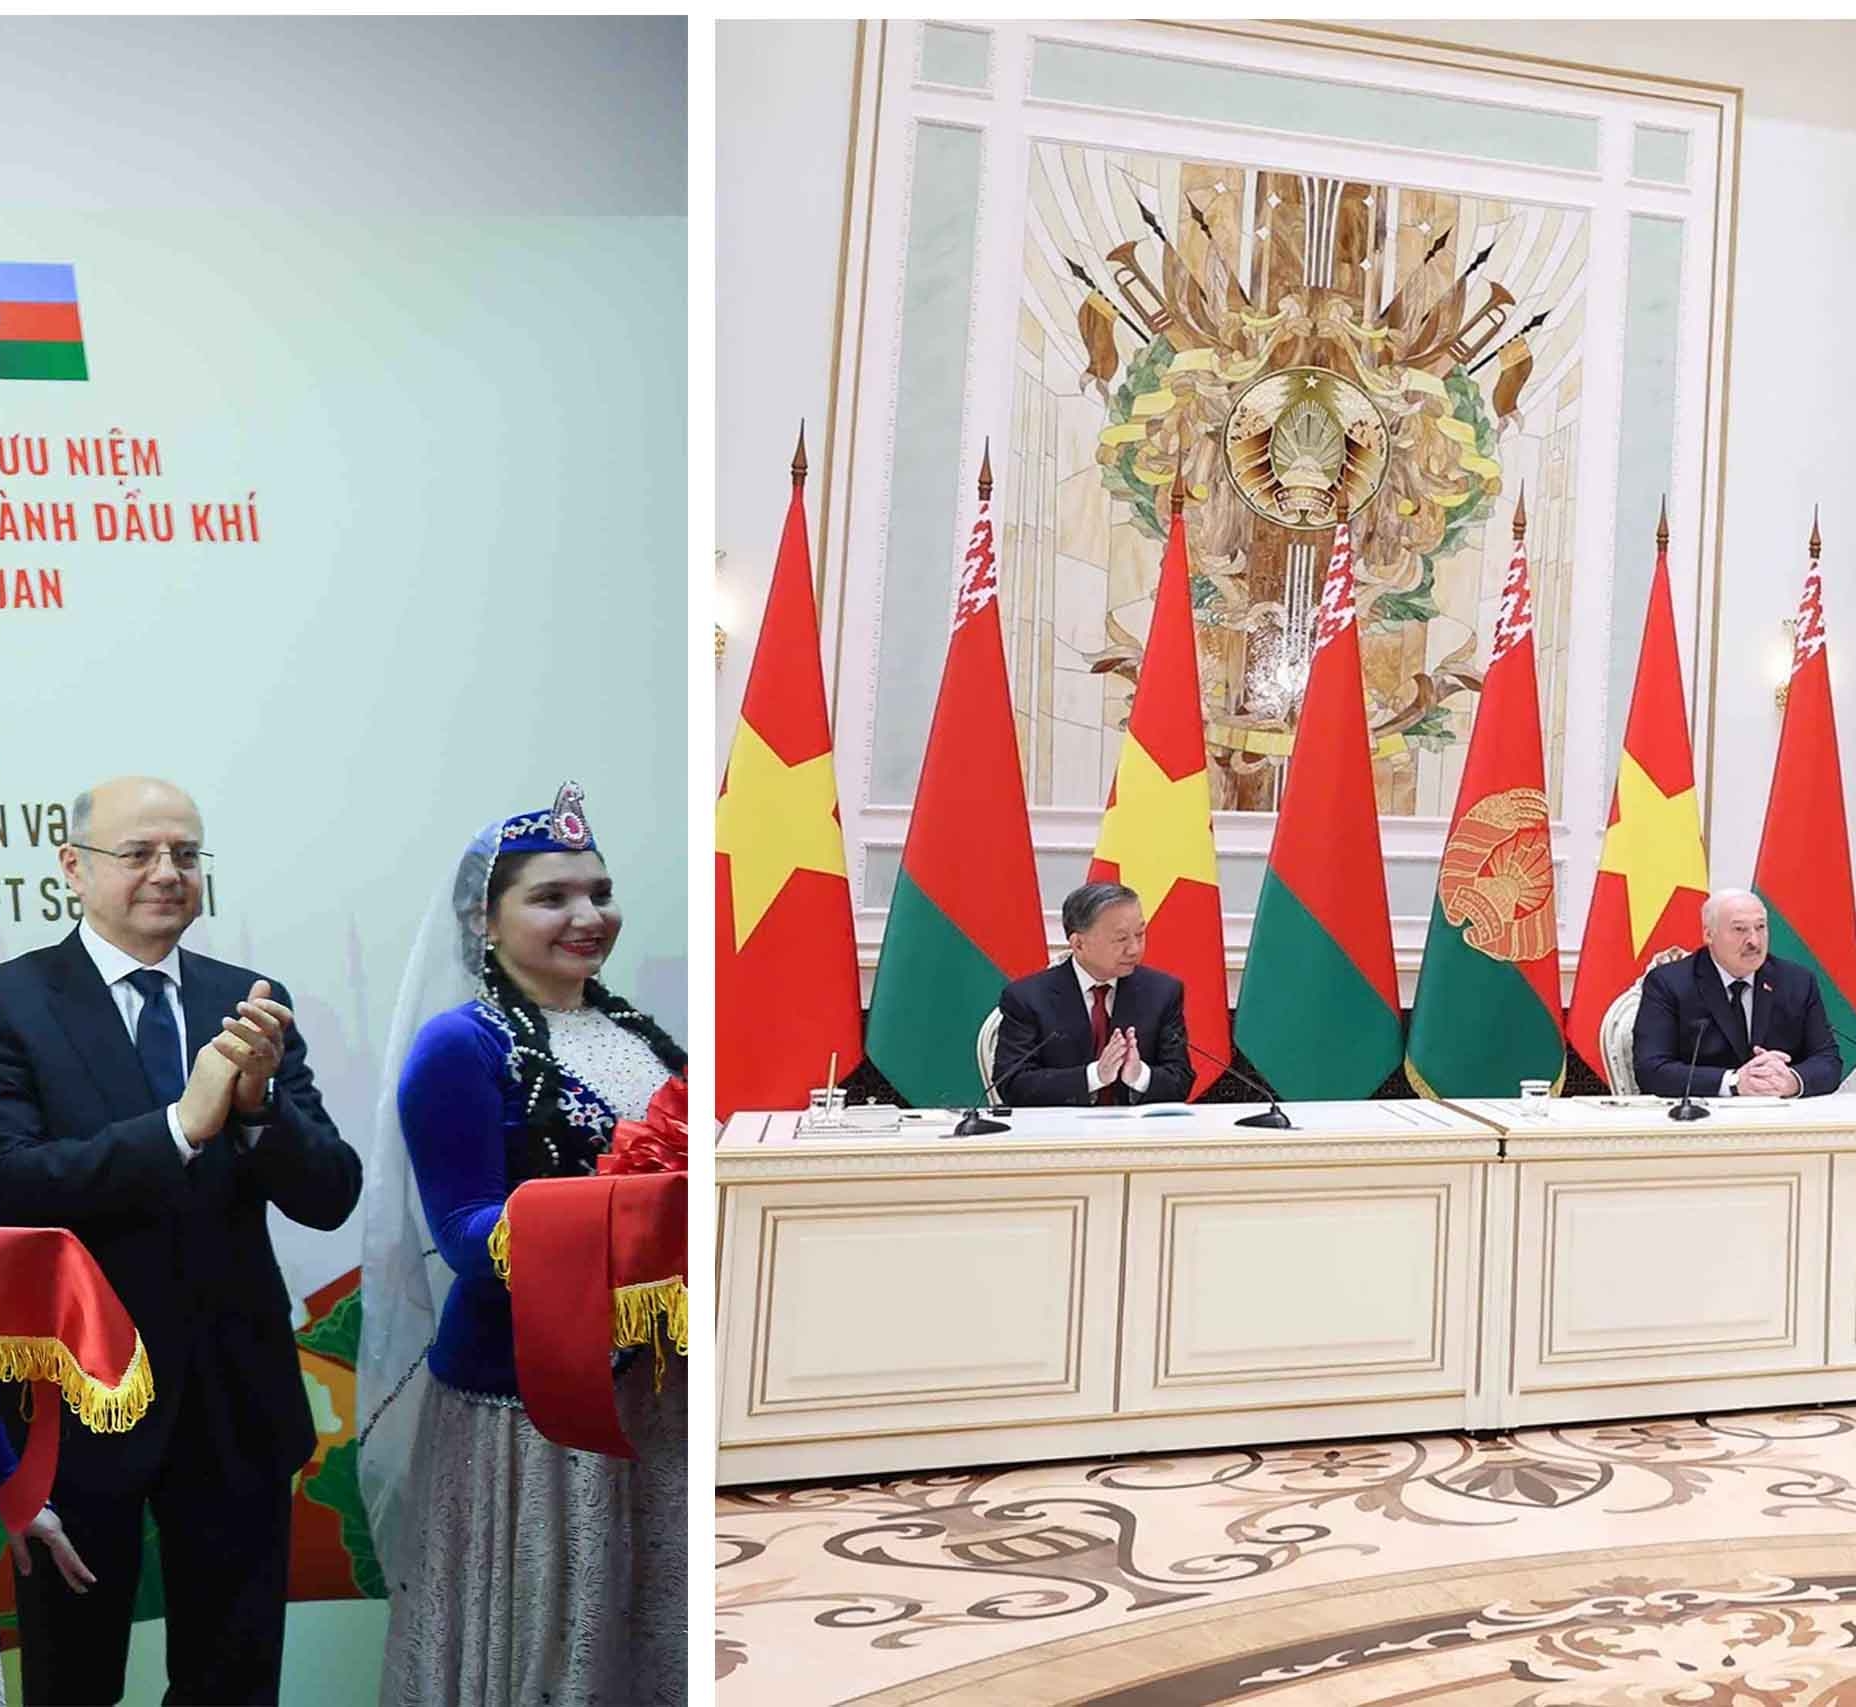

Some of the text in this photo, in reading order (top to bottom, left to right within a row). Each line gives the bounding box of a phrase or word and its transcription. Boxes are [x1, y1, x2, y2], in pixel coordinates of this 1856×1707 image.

[66, 427, 162, 486] NIỆM
[190, 490, 261, 542] KHÍ
[21, 802, 68, 846] VƏ
